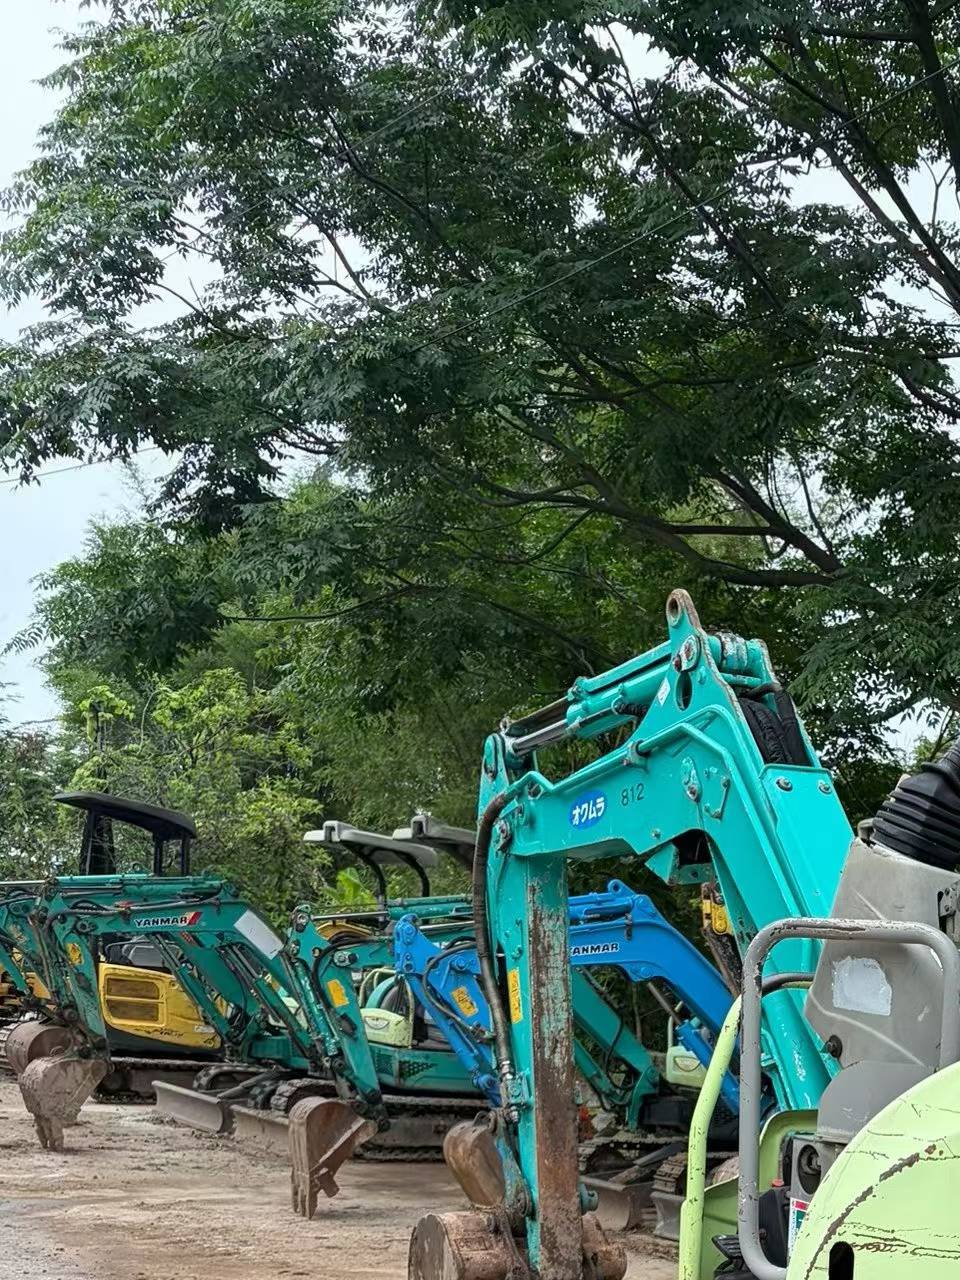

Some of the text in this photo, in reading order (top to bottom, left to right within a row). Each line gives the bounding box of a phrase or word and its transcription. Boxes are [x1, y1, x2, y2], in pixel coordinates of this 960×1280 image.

[621, 783, 644, 806] 812
[572, 797, 605, 825] オクムラ
[135, 916, 188, 928] YANMAR
[570, 942, 620, 956] ANMAR
